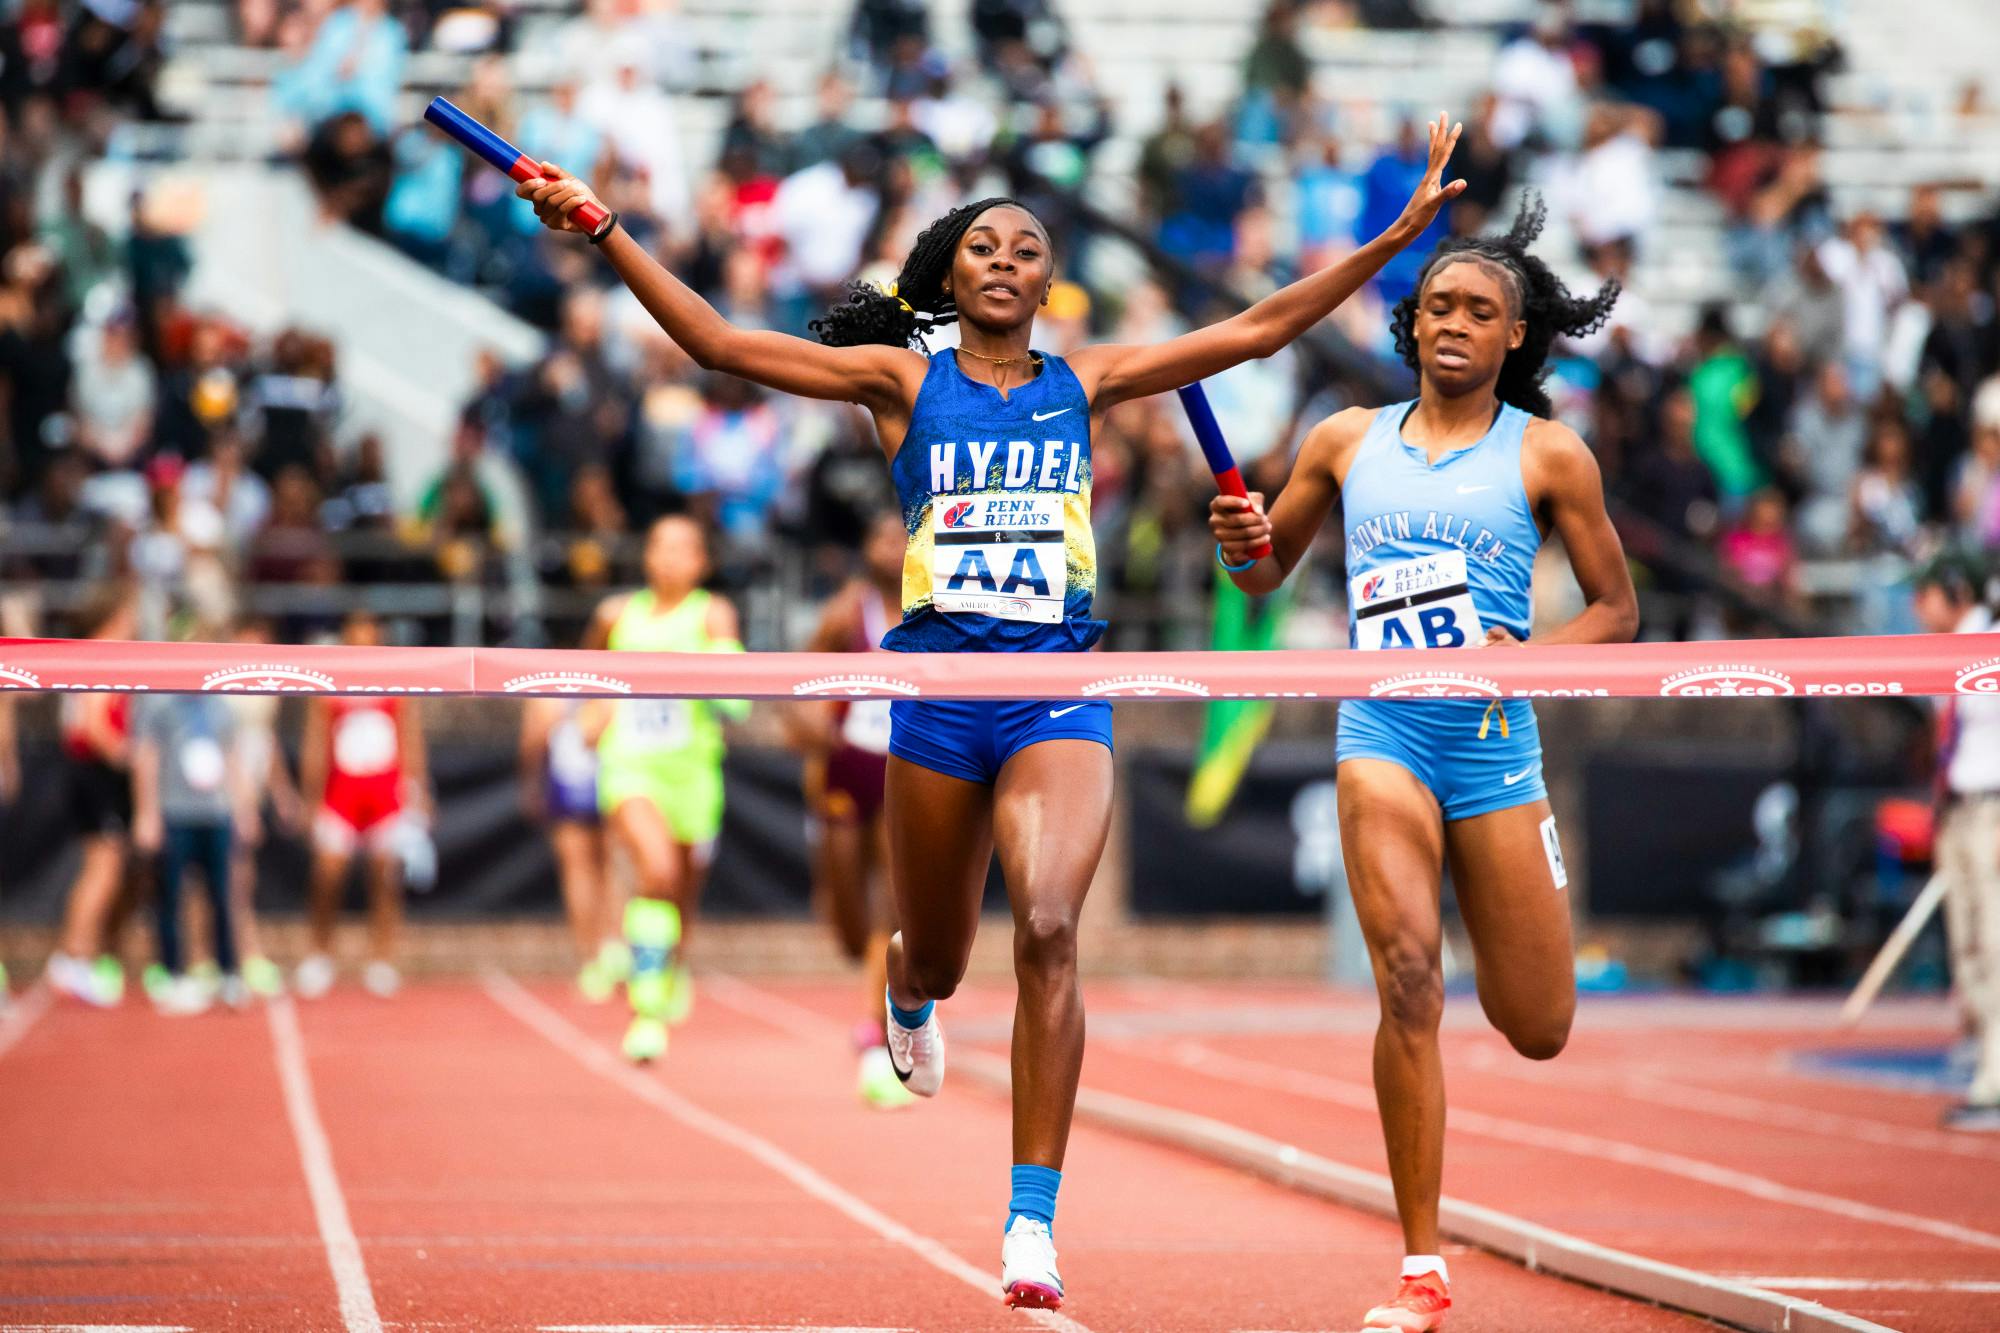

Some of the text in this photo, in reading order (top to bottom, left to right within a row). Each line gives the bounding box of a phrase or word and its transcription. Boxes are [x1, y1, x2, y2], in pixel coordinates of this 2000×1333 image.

[930, 440, 1081, 493] HYDEL
[985, 500, 1036, 513] PENN
[984, 513, 1050, 527] RELAYS
[1348, 510, 1507, 565] EDWIN ALLEN
[946, 548, 1050, 596] AA
[1395, 561, 1438, 580] PENN
[1394, 572, 1453, 593] RELAYS
[1380, 606, 1466, 649] AB
[204, 664, 257, 681] QUALITY
[503, 672, 556, 688] QUALITY
[1370, 672, 1422, 690] QUALITY
[1661, 665, 1713, 685] QUALITY
[1717, 664, 1756, 672] SINCE
[1679, 682, 1904, 696] Grace FOODS
